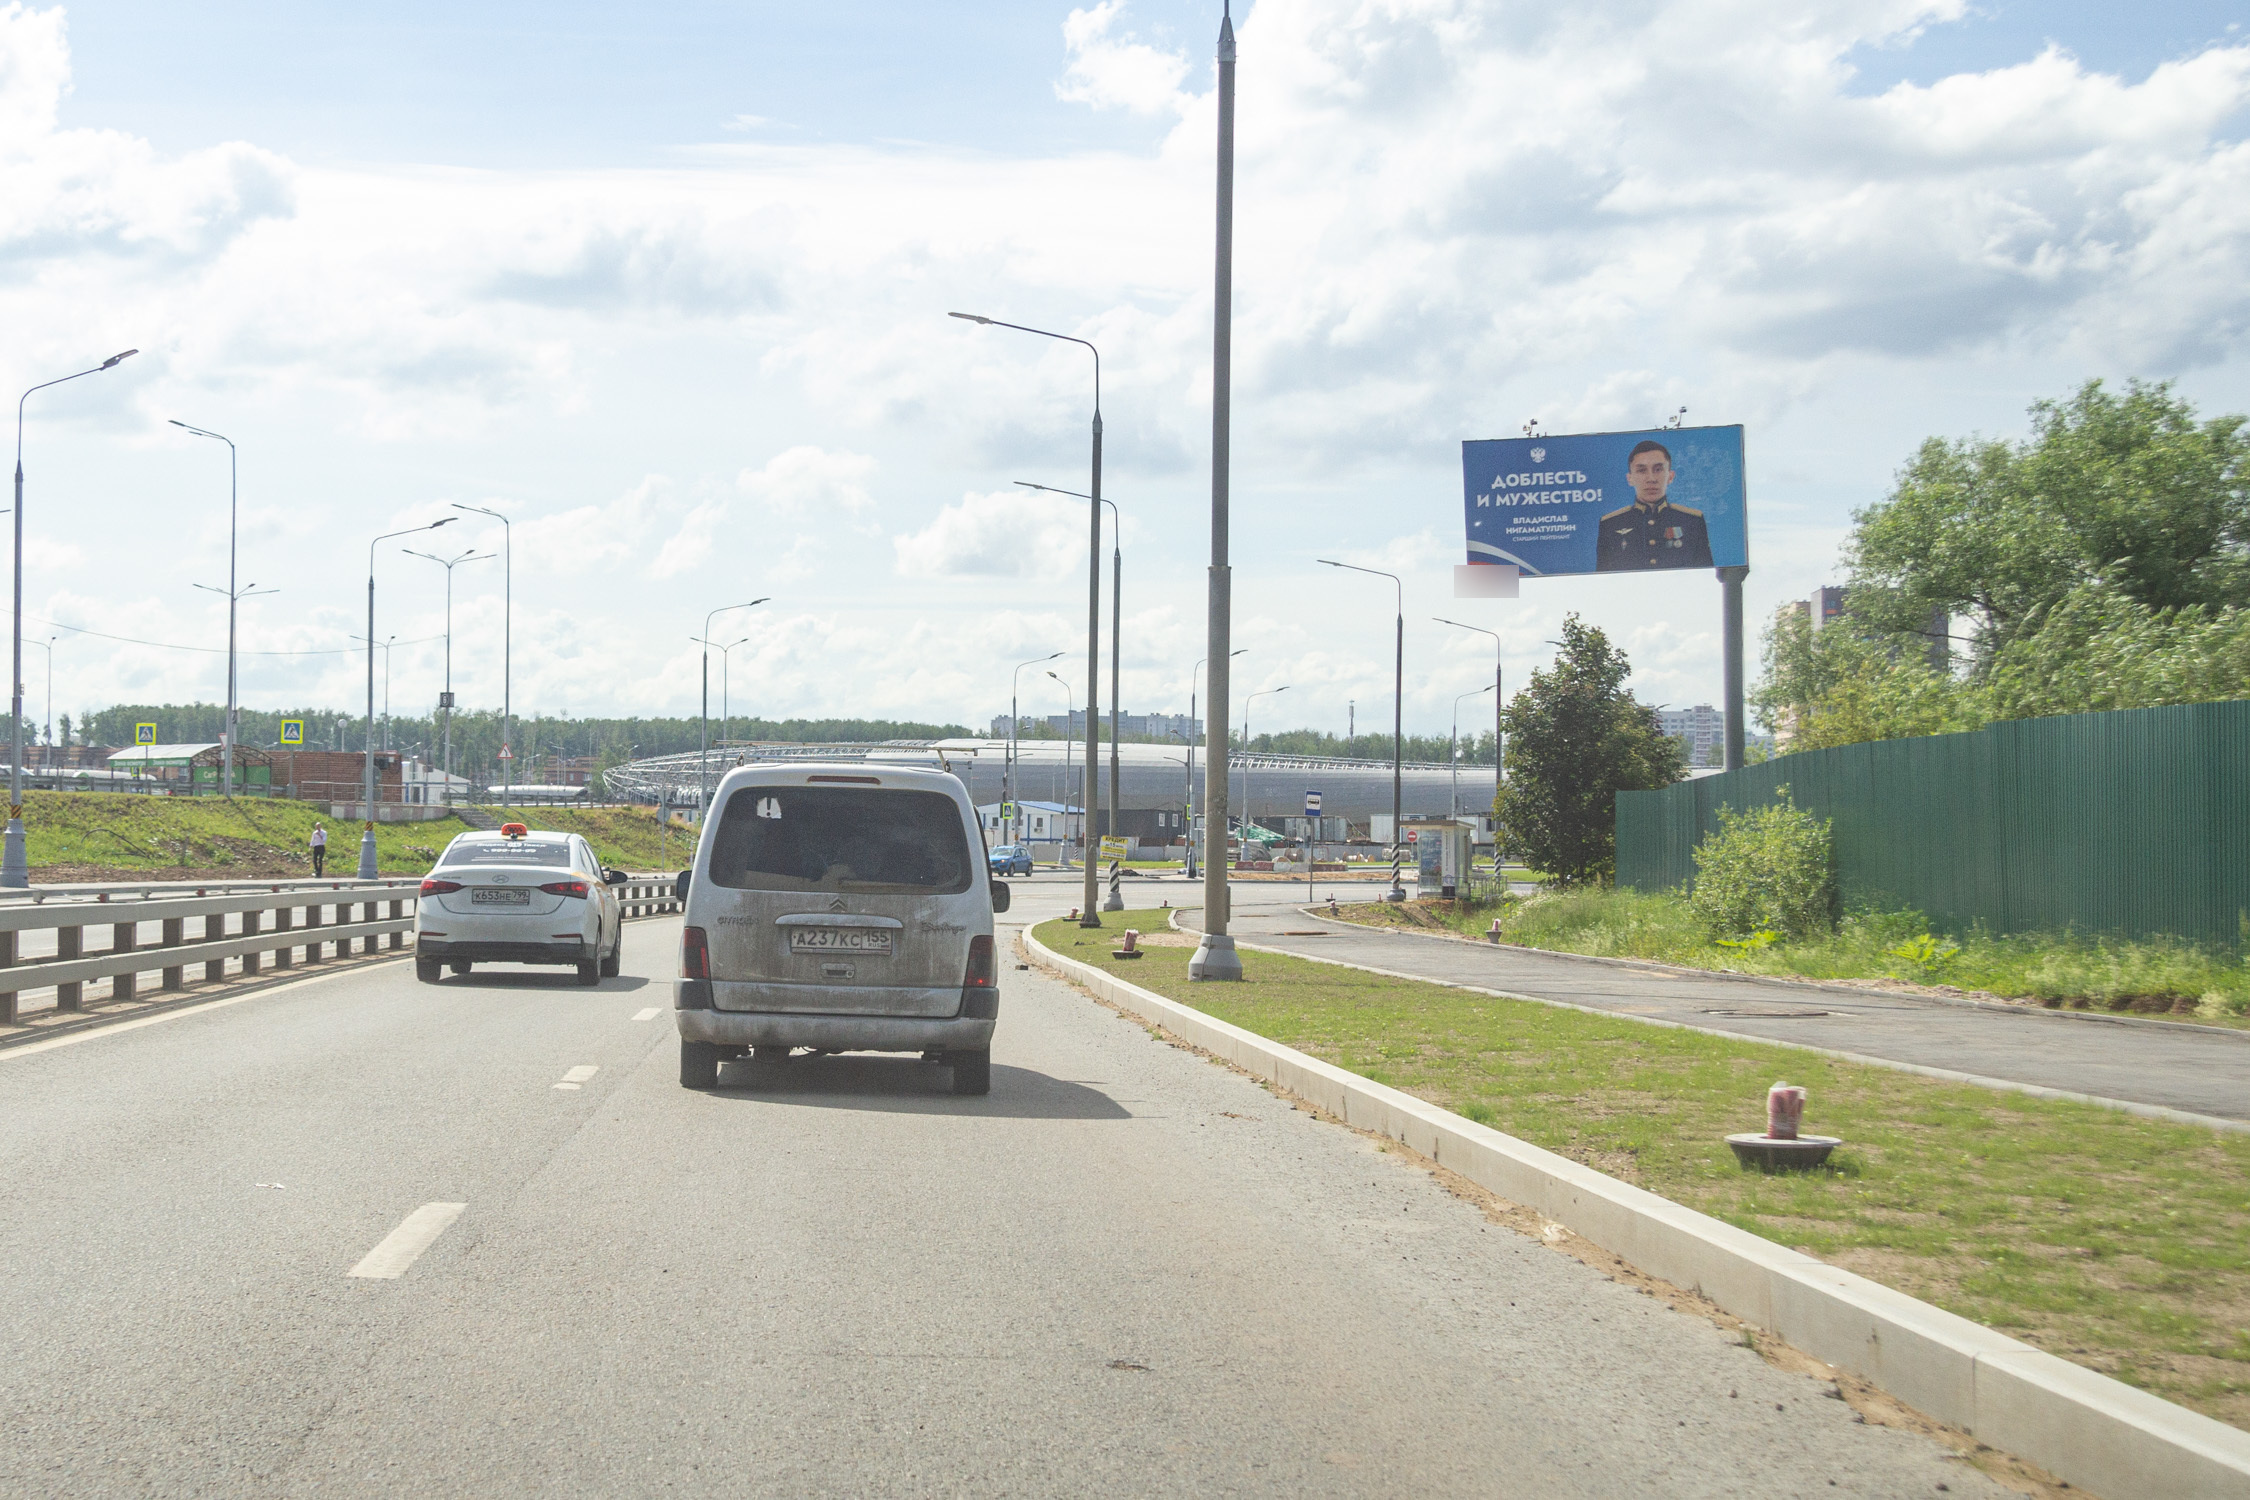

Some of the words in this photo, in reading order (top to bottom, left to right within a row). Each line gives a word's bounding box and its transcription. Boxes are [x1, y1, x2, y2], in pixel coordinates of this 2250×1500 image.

[1491, 471, 1587, 490] ДОБЛЕСТЬ
[1476, 494, 1490, 508] И
[1495, 489, 1603, 507] МУЖЕСТВО!
[1513, 515, 1569, 525] ВЛАДИСЛАВ
[1505, 524, 1576, 535] НИГАМАТУЛЛИН
[475, 891, 511, 901] К653НЕ
[513, 891, 527, 899] 799
[796, 930, 860, 947] А237КС
[863, 930, 890, 943] 155
